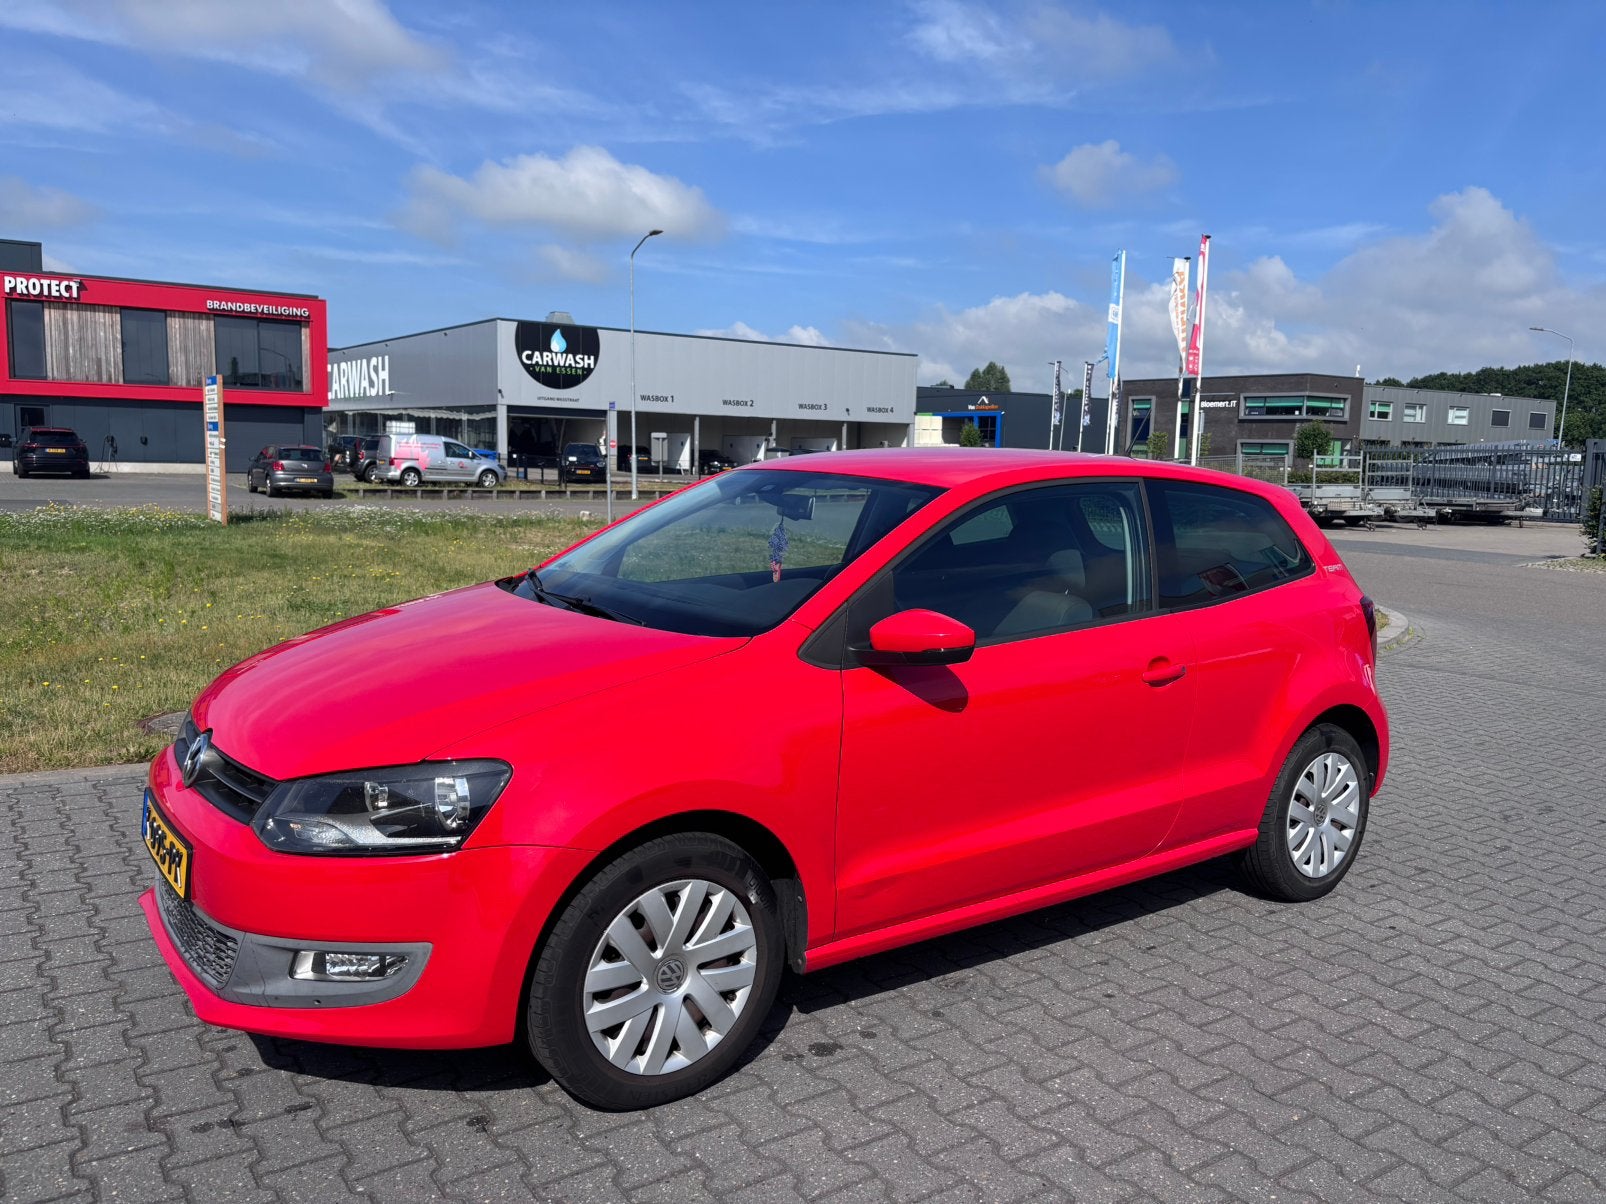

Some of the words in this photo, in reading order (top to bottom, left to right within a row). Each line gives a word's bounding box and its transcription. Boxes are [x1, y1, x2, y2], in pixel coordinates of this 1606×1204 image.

[4, 276, 80, 298] PROTECT
[206, 300, 310, 317] BRANDBEVEILIGING
[521, 350, 595, 369] CARWASH
[556, 367, 582, 375] ESSEN
[640, 394, 669, 402] WASBOX
[722, 399, 748, 407] WASBOX
[798, 403, 822, 411] WASBOX
[823, 403, 828, 411] 3
